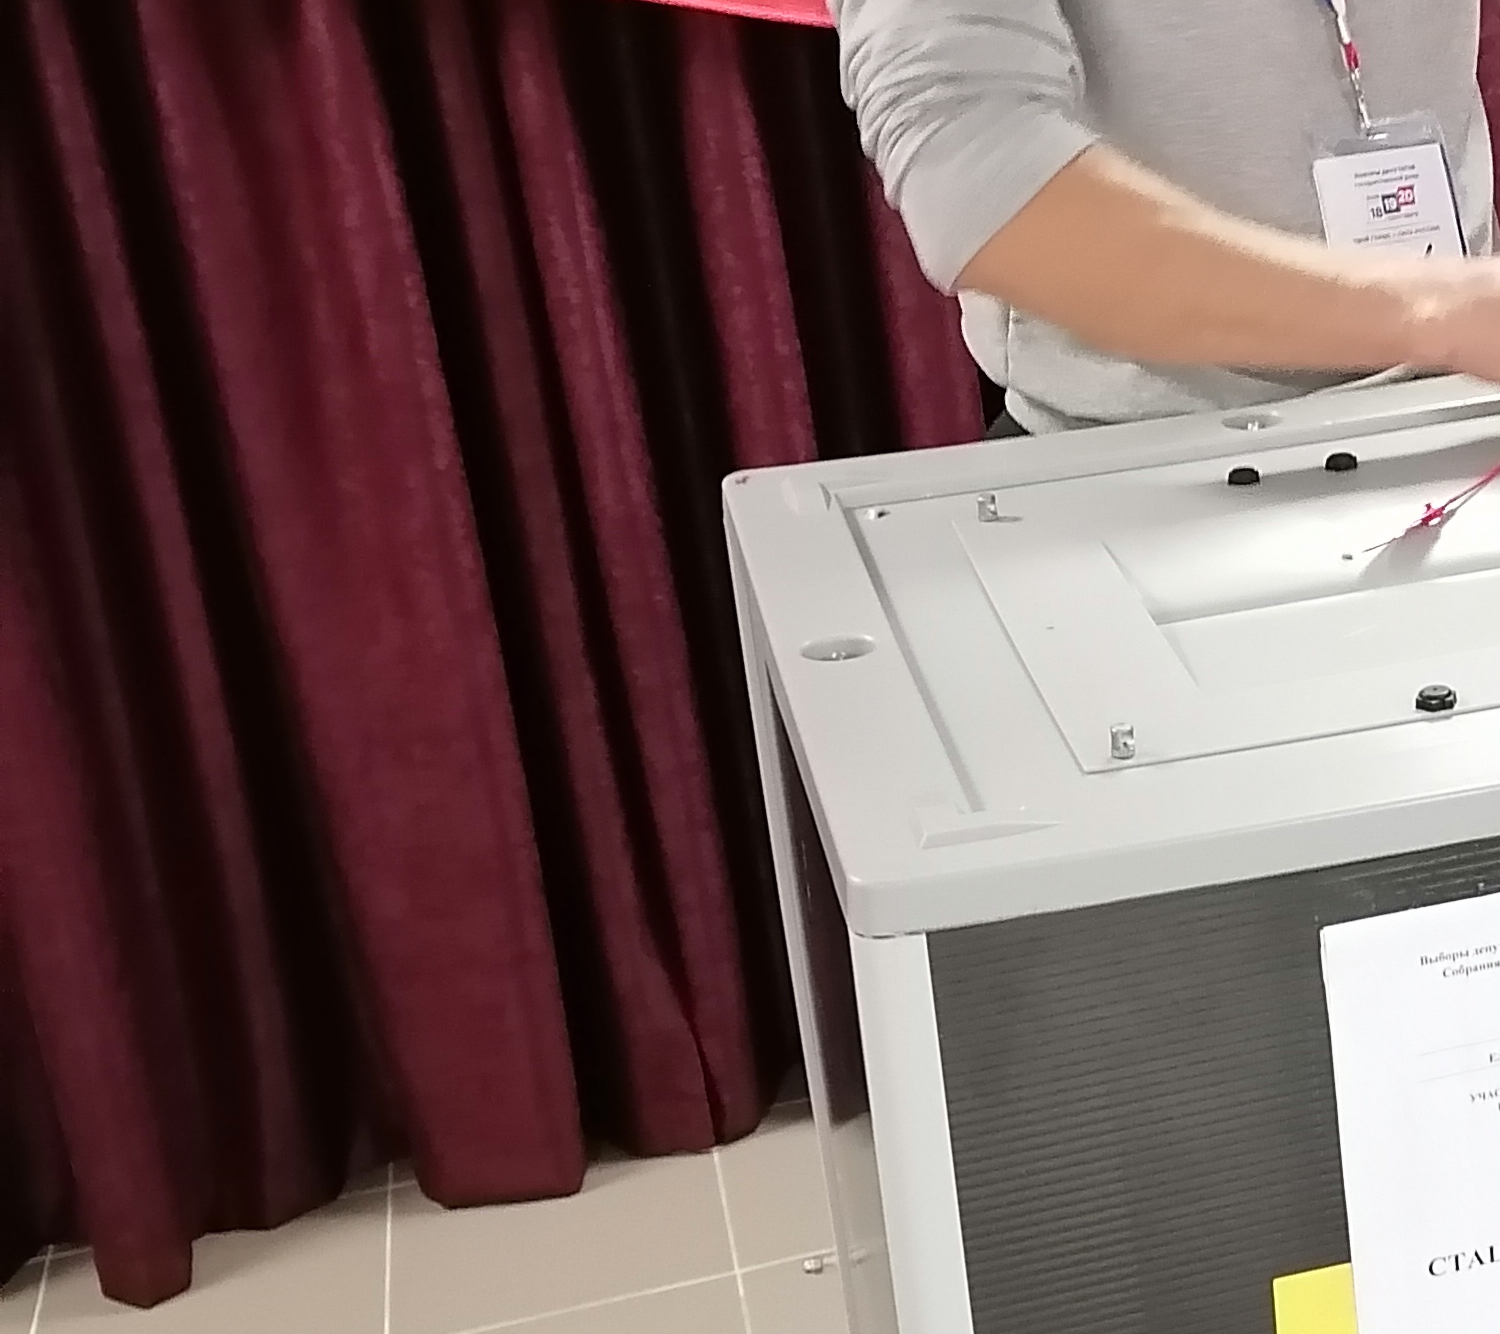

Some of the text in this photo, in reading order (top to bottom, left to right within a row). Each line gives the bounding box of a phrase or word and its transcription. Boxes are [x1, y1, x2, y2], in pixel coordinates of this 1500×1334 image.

[1398, 188, 1414, 203] 20
[1420, 948, 1469, 967] Выборы
[1442, 960, 1500, 979] Собрания
